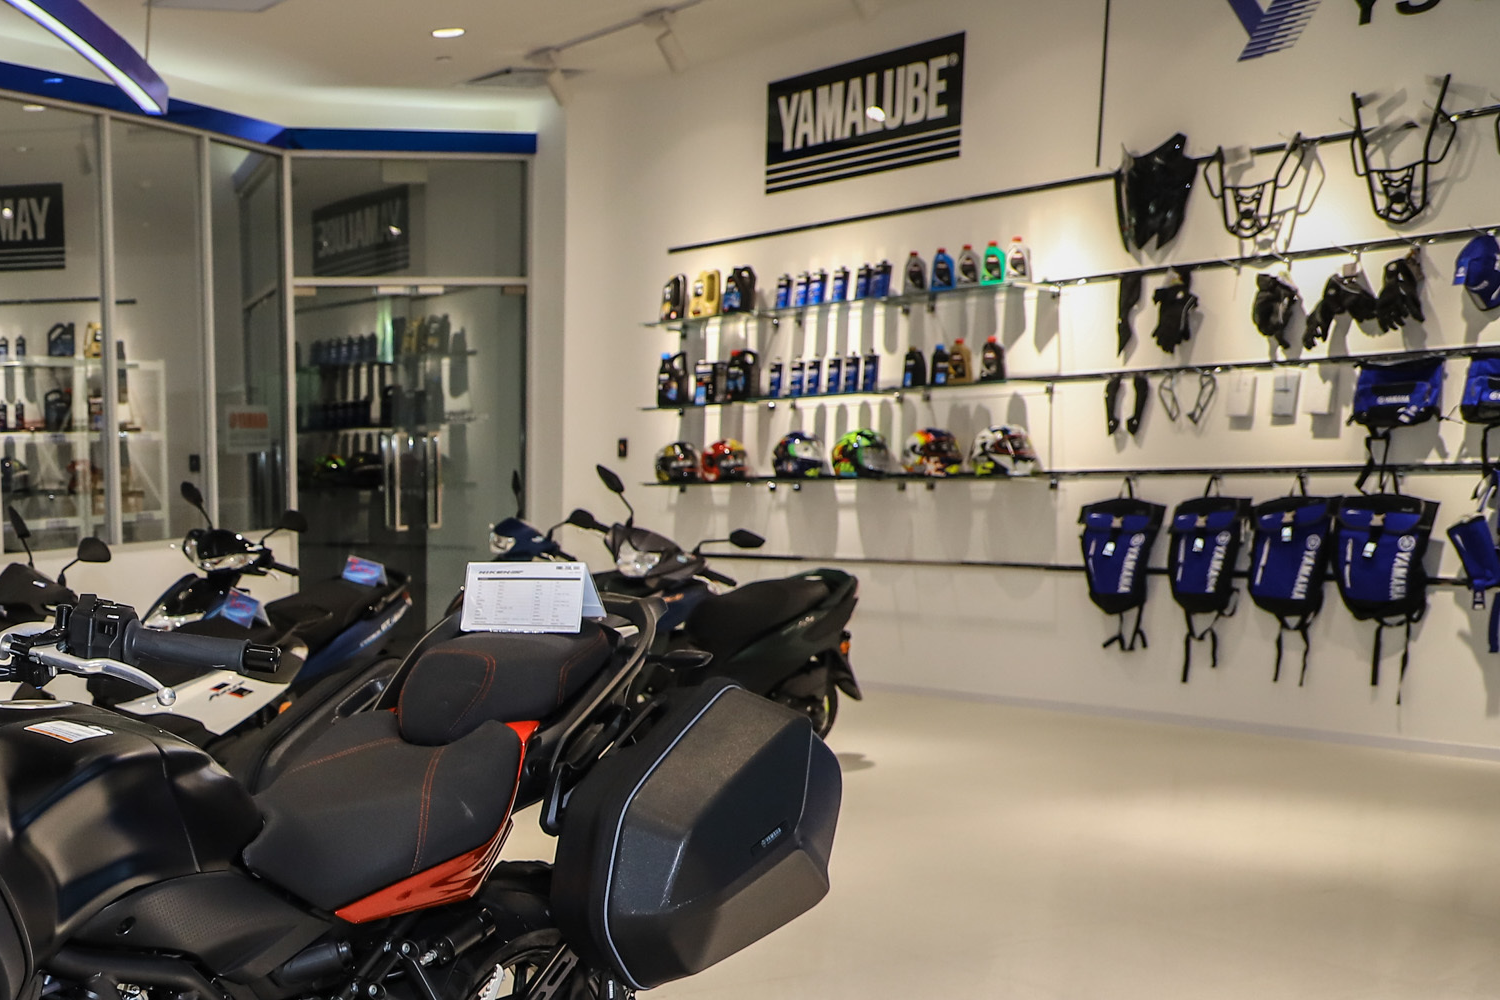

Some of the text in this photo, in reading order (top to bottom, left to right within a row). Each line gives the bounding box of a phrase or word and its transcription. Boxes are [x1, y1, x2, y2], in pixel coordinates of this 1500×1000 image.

[778, 55, 949, 153] YAMALUBE
[1290, 550, 1317, 600] YAMAHA
[1389, 551, 1412, 601] YAMAHA
